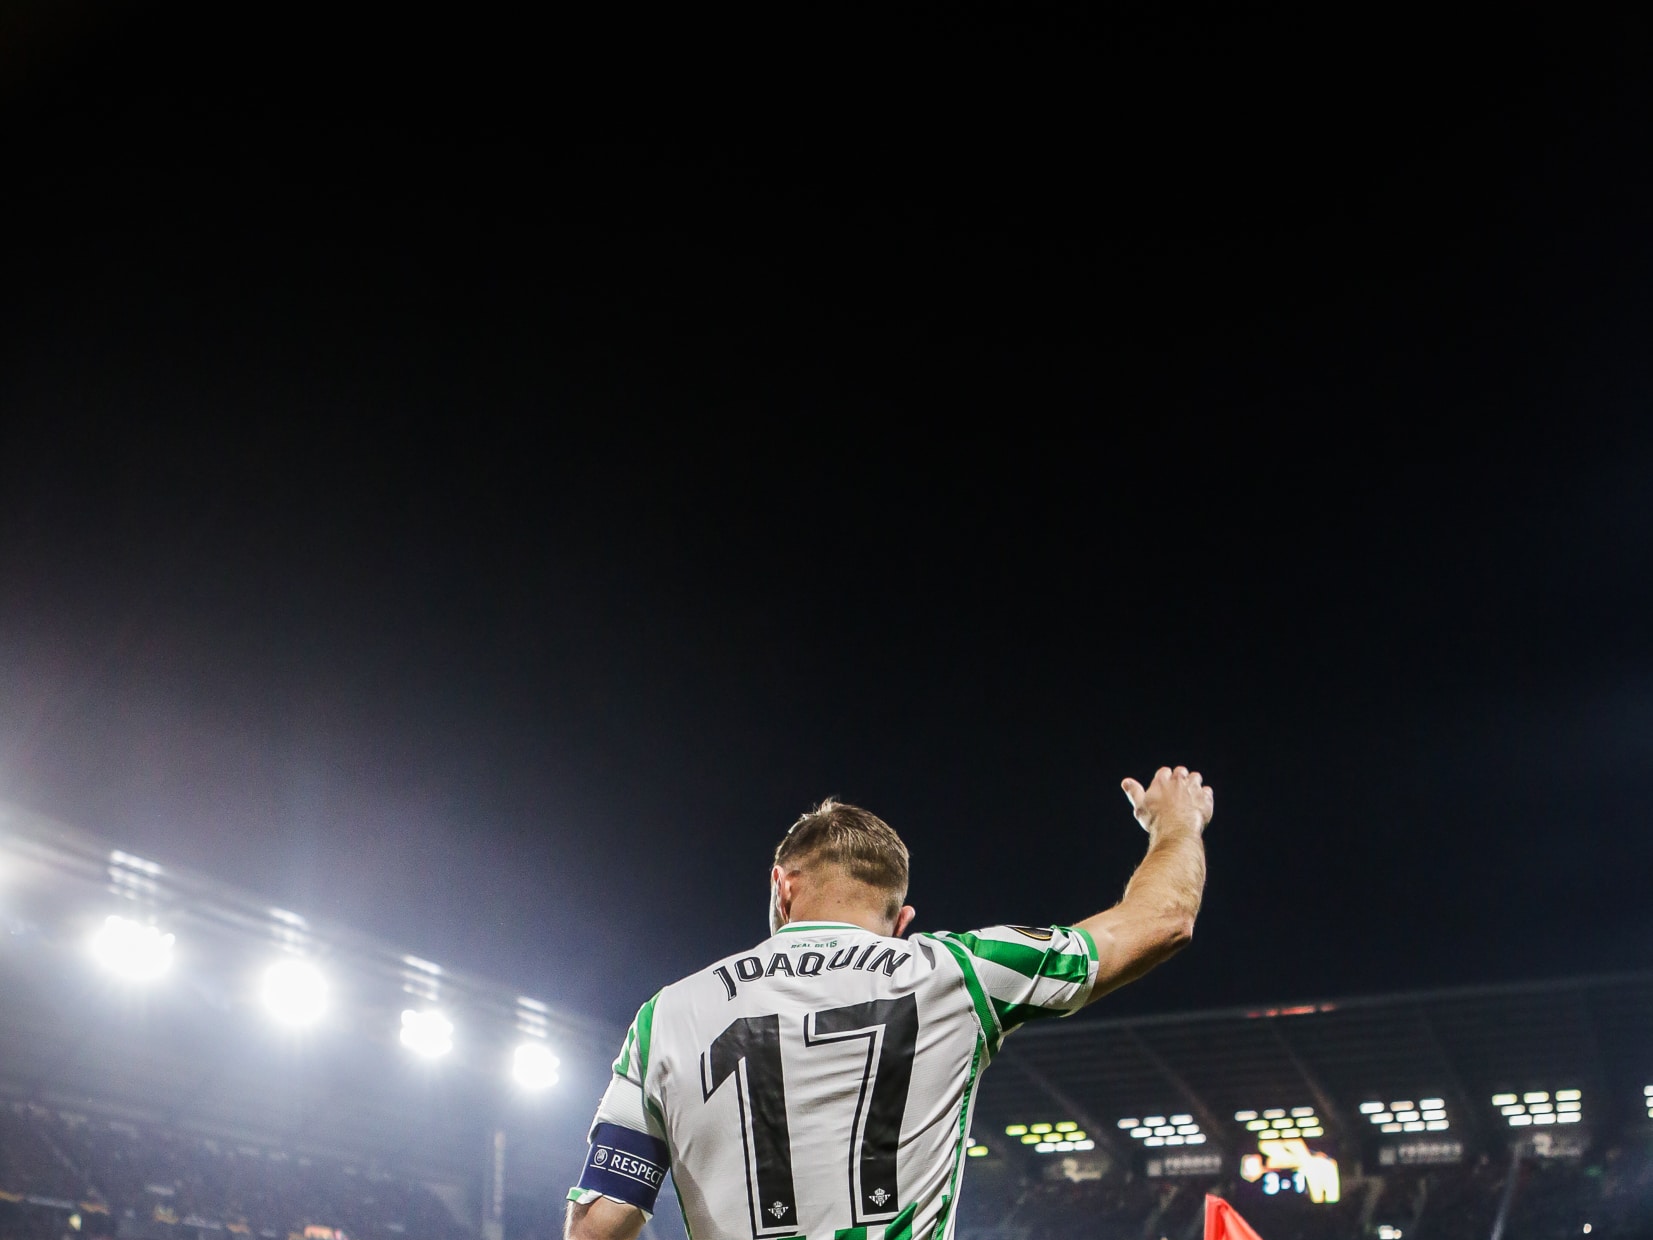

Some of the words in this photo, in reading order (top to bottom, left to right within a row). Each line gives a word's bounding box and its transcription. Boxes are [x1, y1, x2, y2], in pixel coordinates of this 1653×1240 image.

[713, 941, 911, 1001] JOAQUÍN
[700, 992, 919, 1240] 17
[610, 1154, 663, 1185] RESPECT
